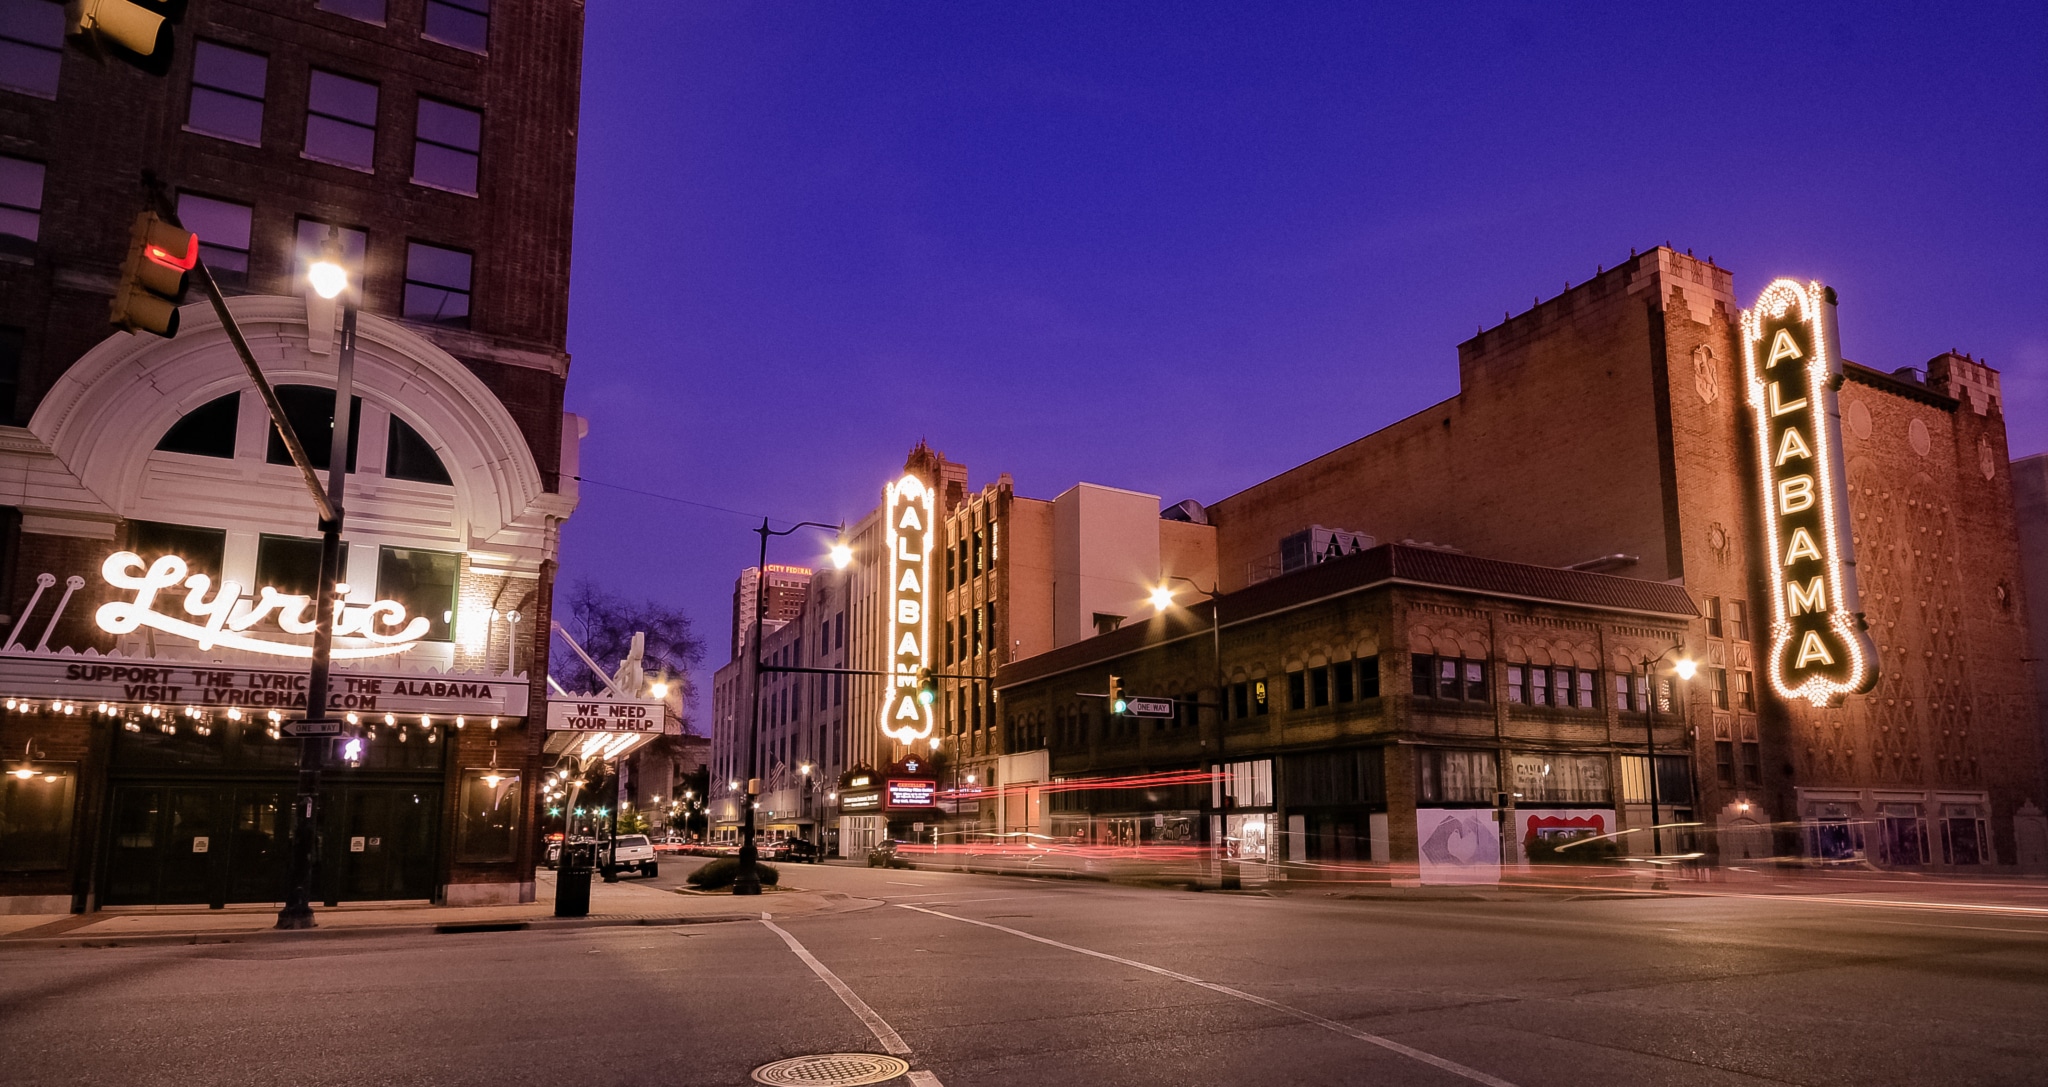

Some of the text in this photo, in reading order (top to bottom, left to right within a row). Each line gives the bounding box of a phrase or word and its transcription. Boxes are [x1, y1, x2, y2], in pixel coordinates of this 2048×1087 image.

[1766, 328, 1834, 669] ALABAMA
[768, 564, 812, 576] CITY FEDERAL
[95, 550, 431, 659] Lyric
[895, 506, 922, 720] ALABAMA
[66, 664, 173, 685] SUPPORT
[192, 671, 234, 688] THE
[248, 673, 306, 691] LYRIC
[345, 678, 382, 694] THE
[393, 680, 493, 699] ALABAMA
[124, 684, 377, 710] VISIT LYRICBHA.COM
[577, 704, 646, 718] WE NEED
[1137, 703, 1167, 712] ONE WAY
[296, 724, 336, 732] ONE WAY
[567, 717, 653, 731] YOUR HELP
